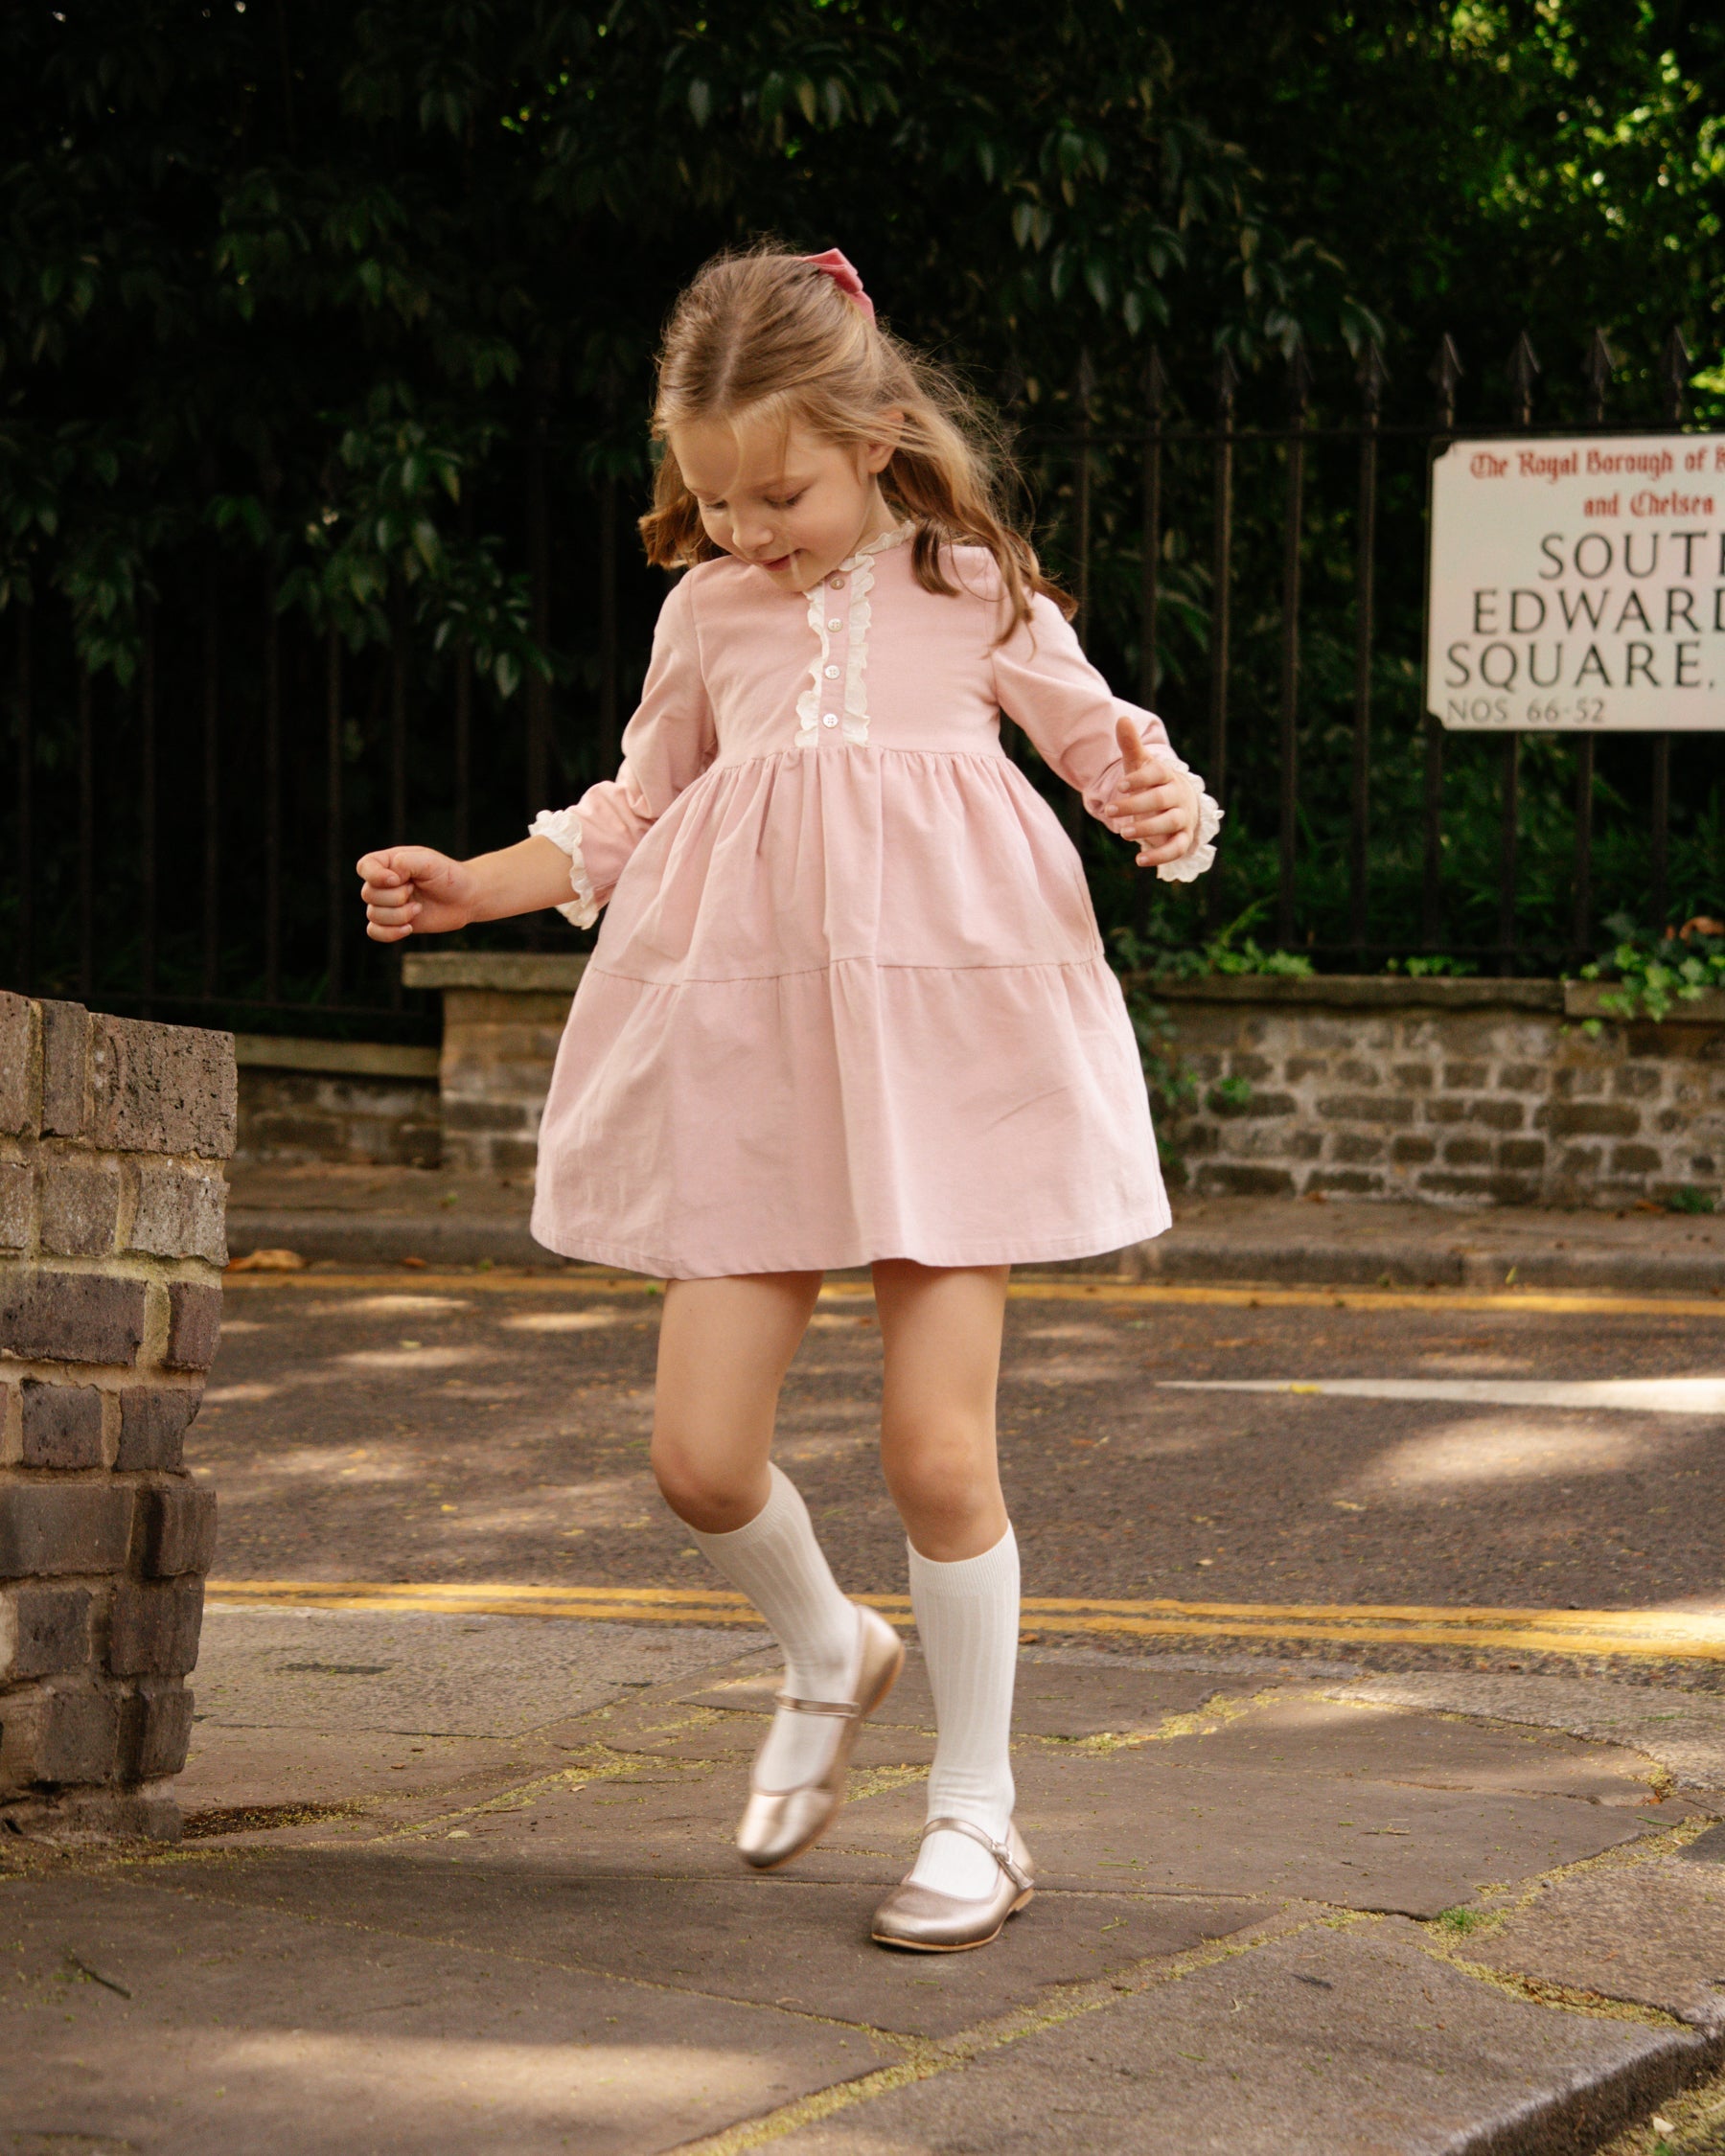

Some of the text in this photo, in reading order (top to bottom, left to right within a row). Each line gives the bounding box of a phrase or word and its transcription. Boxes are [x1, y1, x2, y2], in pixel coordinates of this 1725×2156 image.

[1470, 453, 1508, 479] The
[1517, 451, 1579, 484] Royal
[1586, 447, 1674, 482] Borough
[1684, 446, 1707, 471] of
[1583, 489, 1714, 517] and Chelsea
[1539, 530, 1725, 580] SOUT
[1447, 698, 1509, 723] NOS
